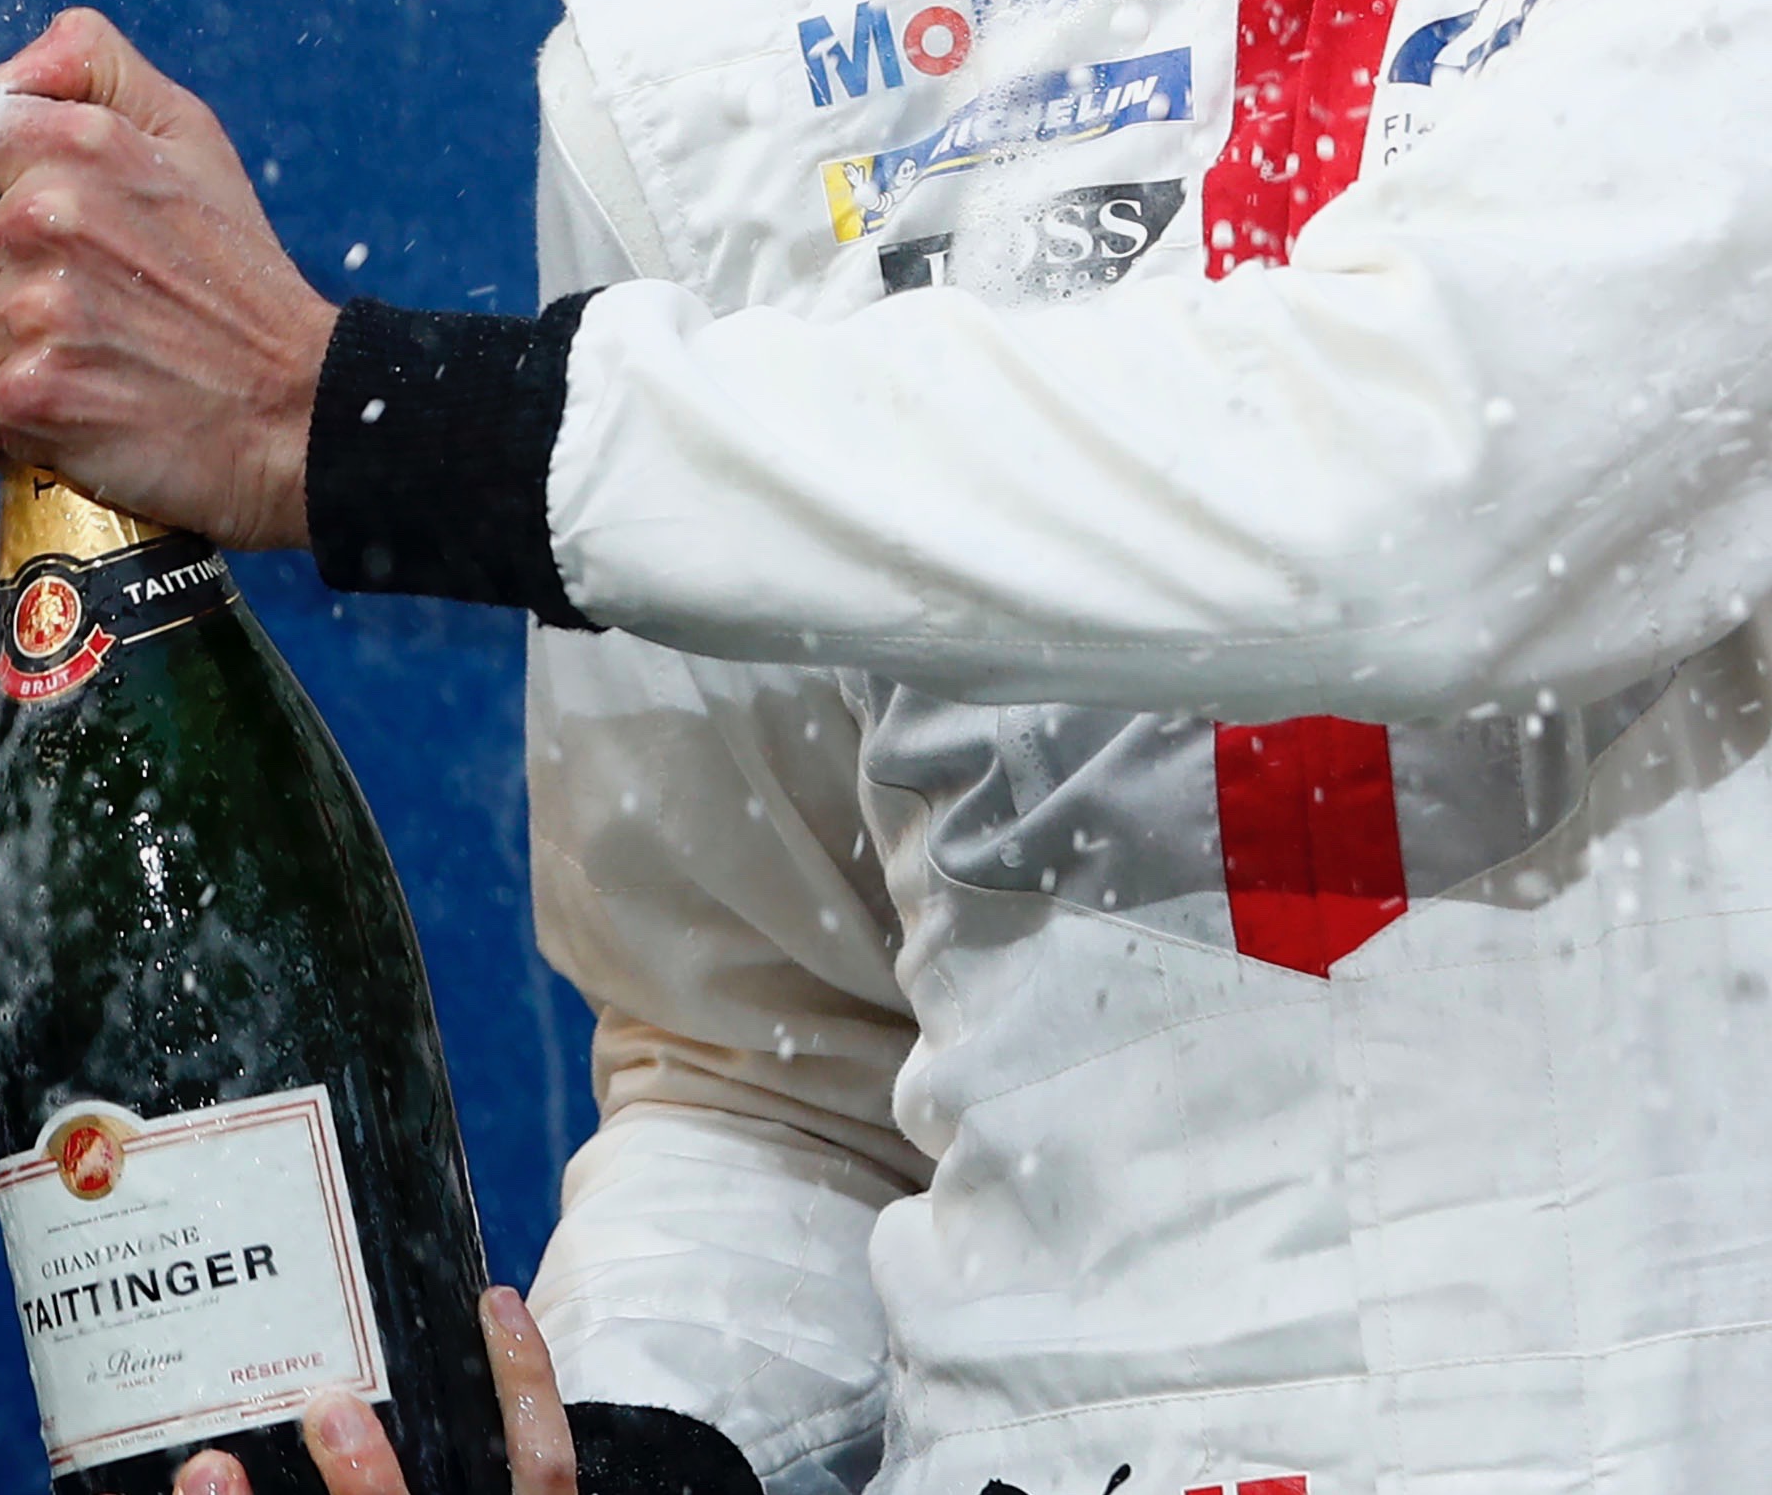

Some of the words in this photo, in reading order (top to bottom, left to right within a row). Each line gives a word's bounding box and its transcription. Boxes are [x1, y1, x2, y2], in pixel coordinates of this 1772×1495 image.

[19, 669, 72, 696] BRUT
[40, 1225, 201, 1280] CHAMPAGNE
[23, 1243, 279, 1337] TAITTINGER
[230, 1352, 326, 1384] RÉSERVE
